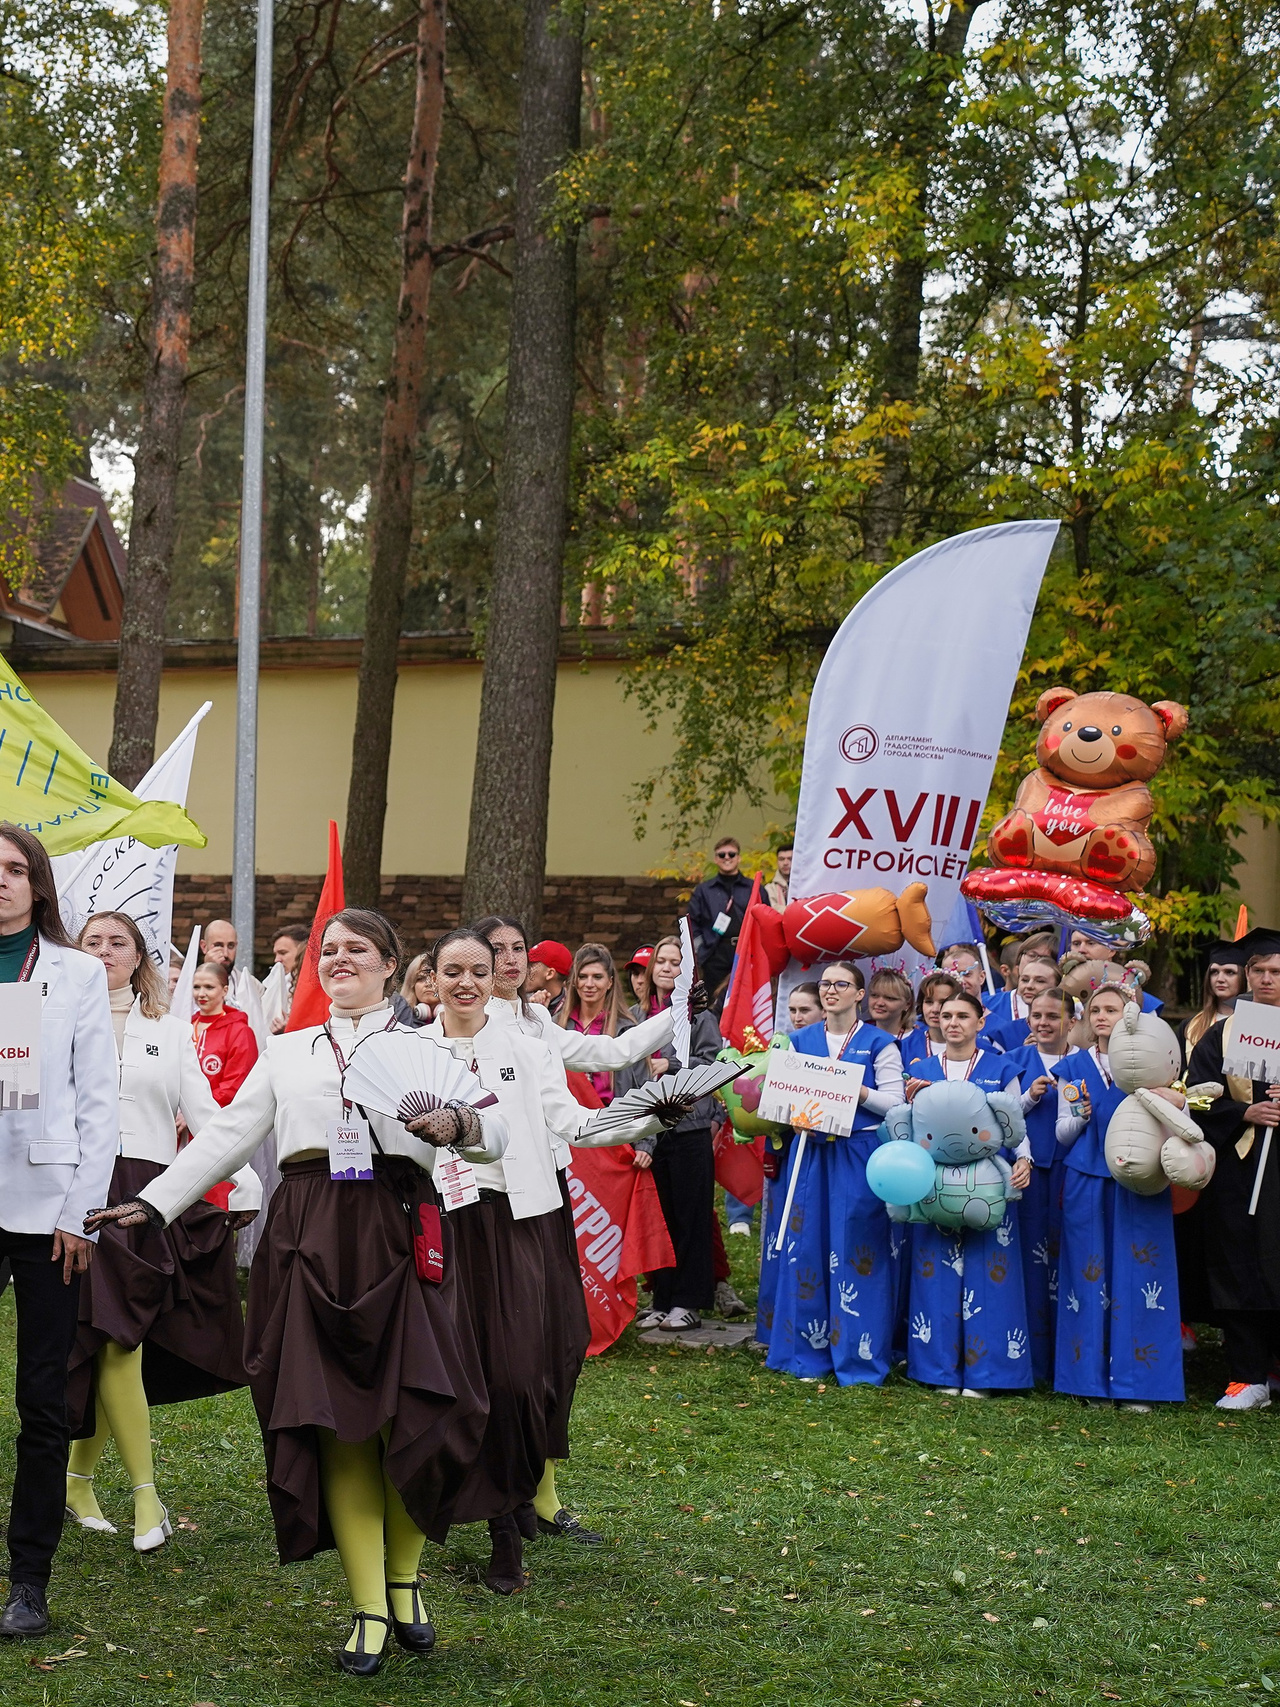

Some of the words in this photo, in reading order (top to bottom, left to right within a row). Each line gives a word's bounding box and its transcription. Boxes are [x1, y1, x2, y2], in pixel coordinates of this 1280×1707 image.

[885, 734, 933, 743] ДЕПАРТАМЕНТ
[883, 749, 913, 758] ГОРОДА
[913, 753, 945, 761] МОСКВЫ
[884, 742, 958, 754] ГРАДОСТРОИТЕЛЬНОЙ
[957, 749, 993, 761] ПОЛИТИКИ
[1044, 798, 1088, 819] love
[828, 787, 982, 851] XVIII
[1045, 818, 1086, 836] you
[804, 1061, 847, 1076] МонАрх
[769, 1080, 854, 1104] МОНАРХ-ПРОЕКТ
[337, 1132, 359, 1140] XVIII
